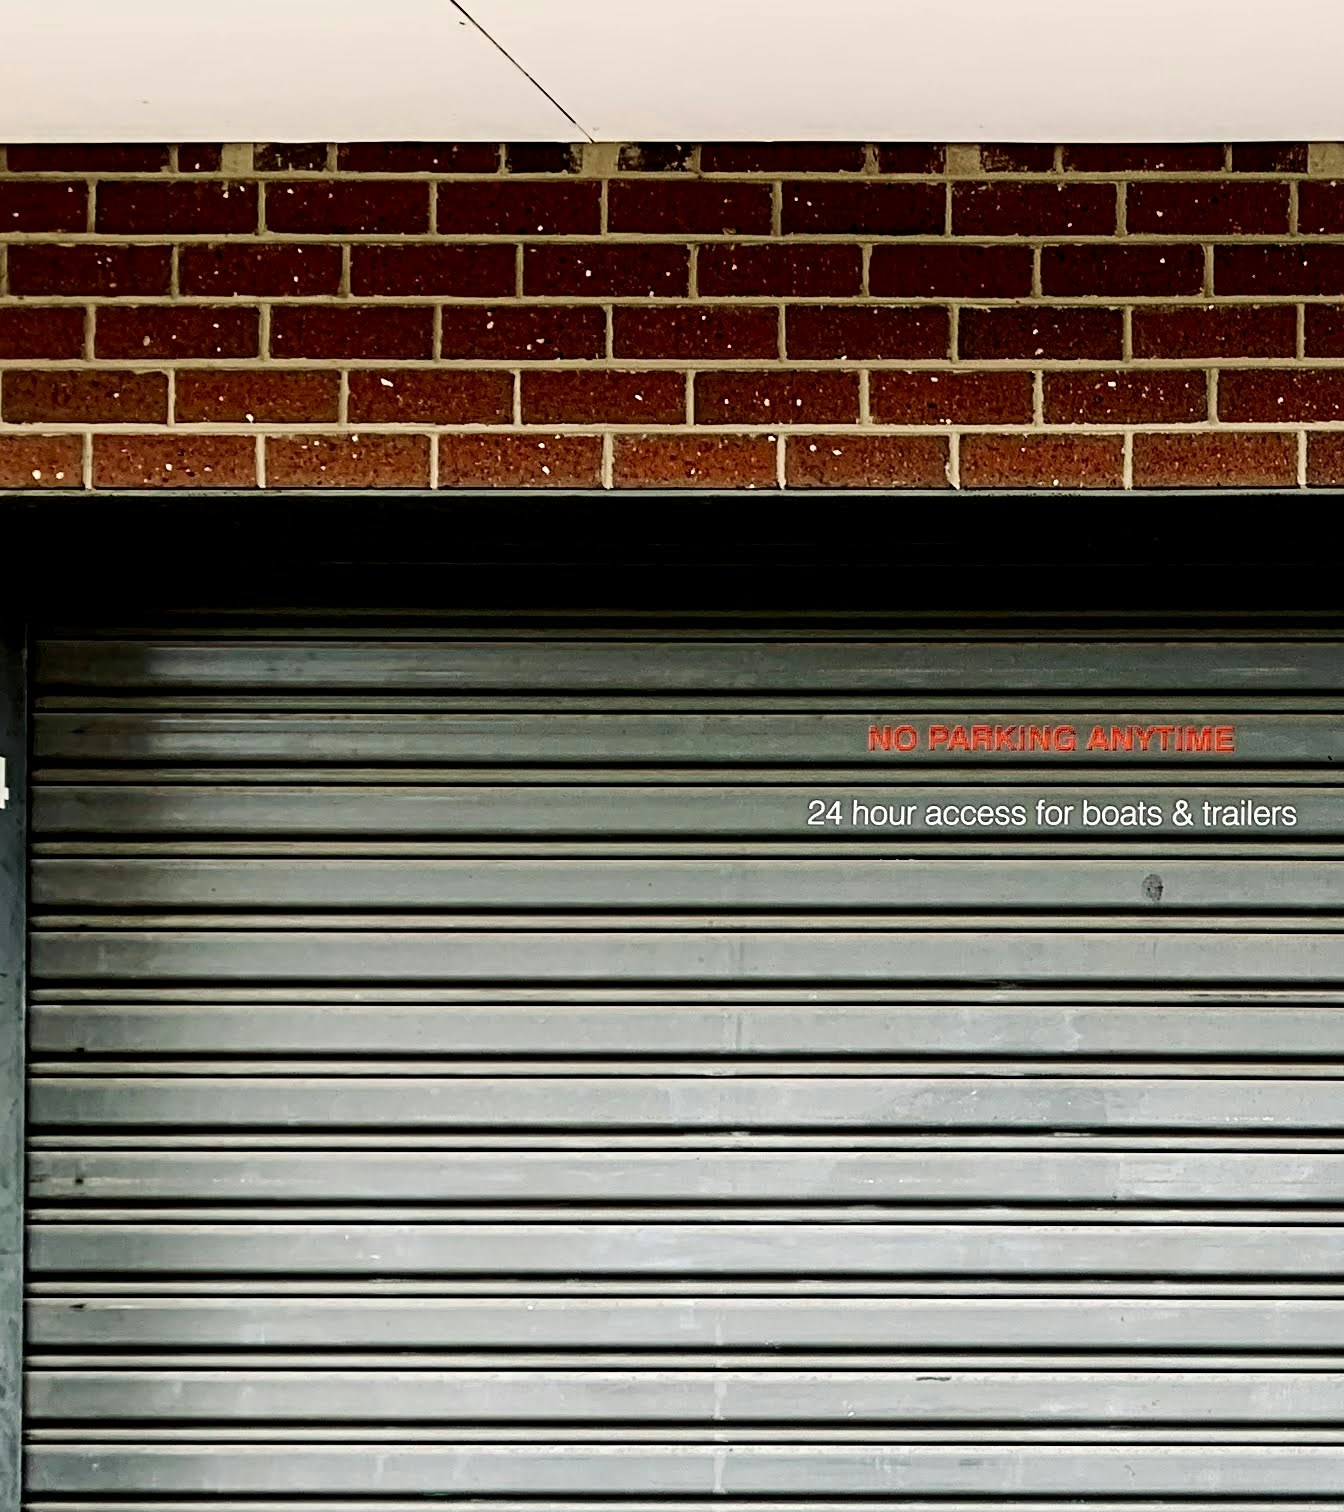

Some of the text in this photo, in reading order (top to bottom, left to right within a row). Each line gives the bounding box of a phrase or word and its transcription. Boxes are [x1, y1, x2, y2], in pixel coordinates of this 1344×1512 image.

[868, 724, 1235, 752] NO PARKING ANYTIME
[807, 799, 1297, 827] 24 hour access for boats & trailers
